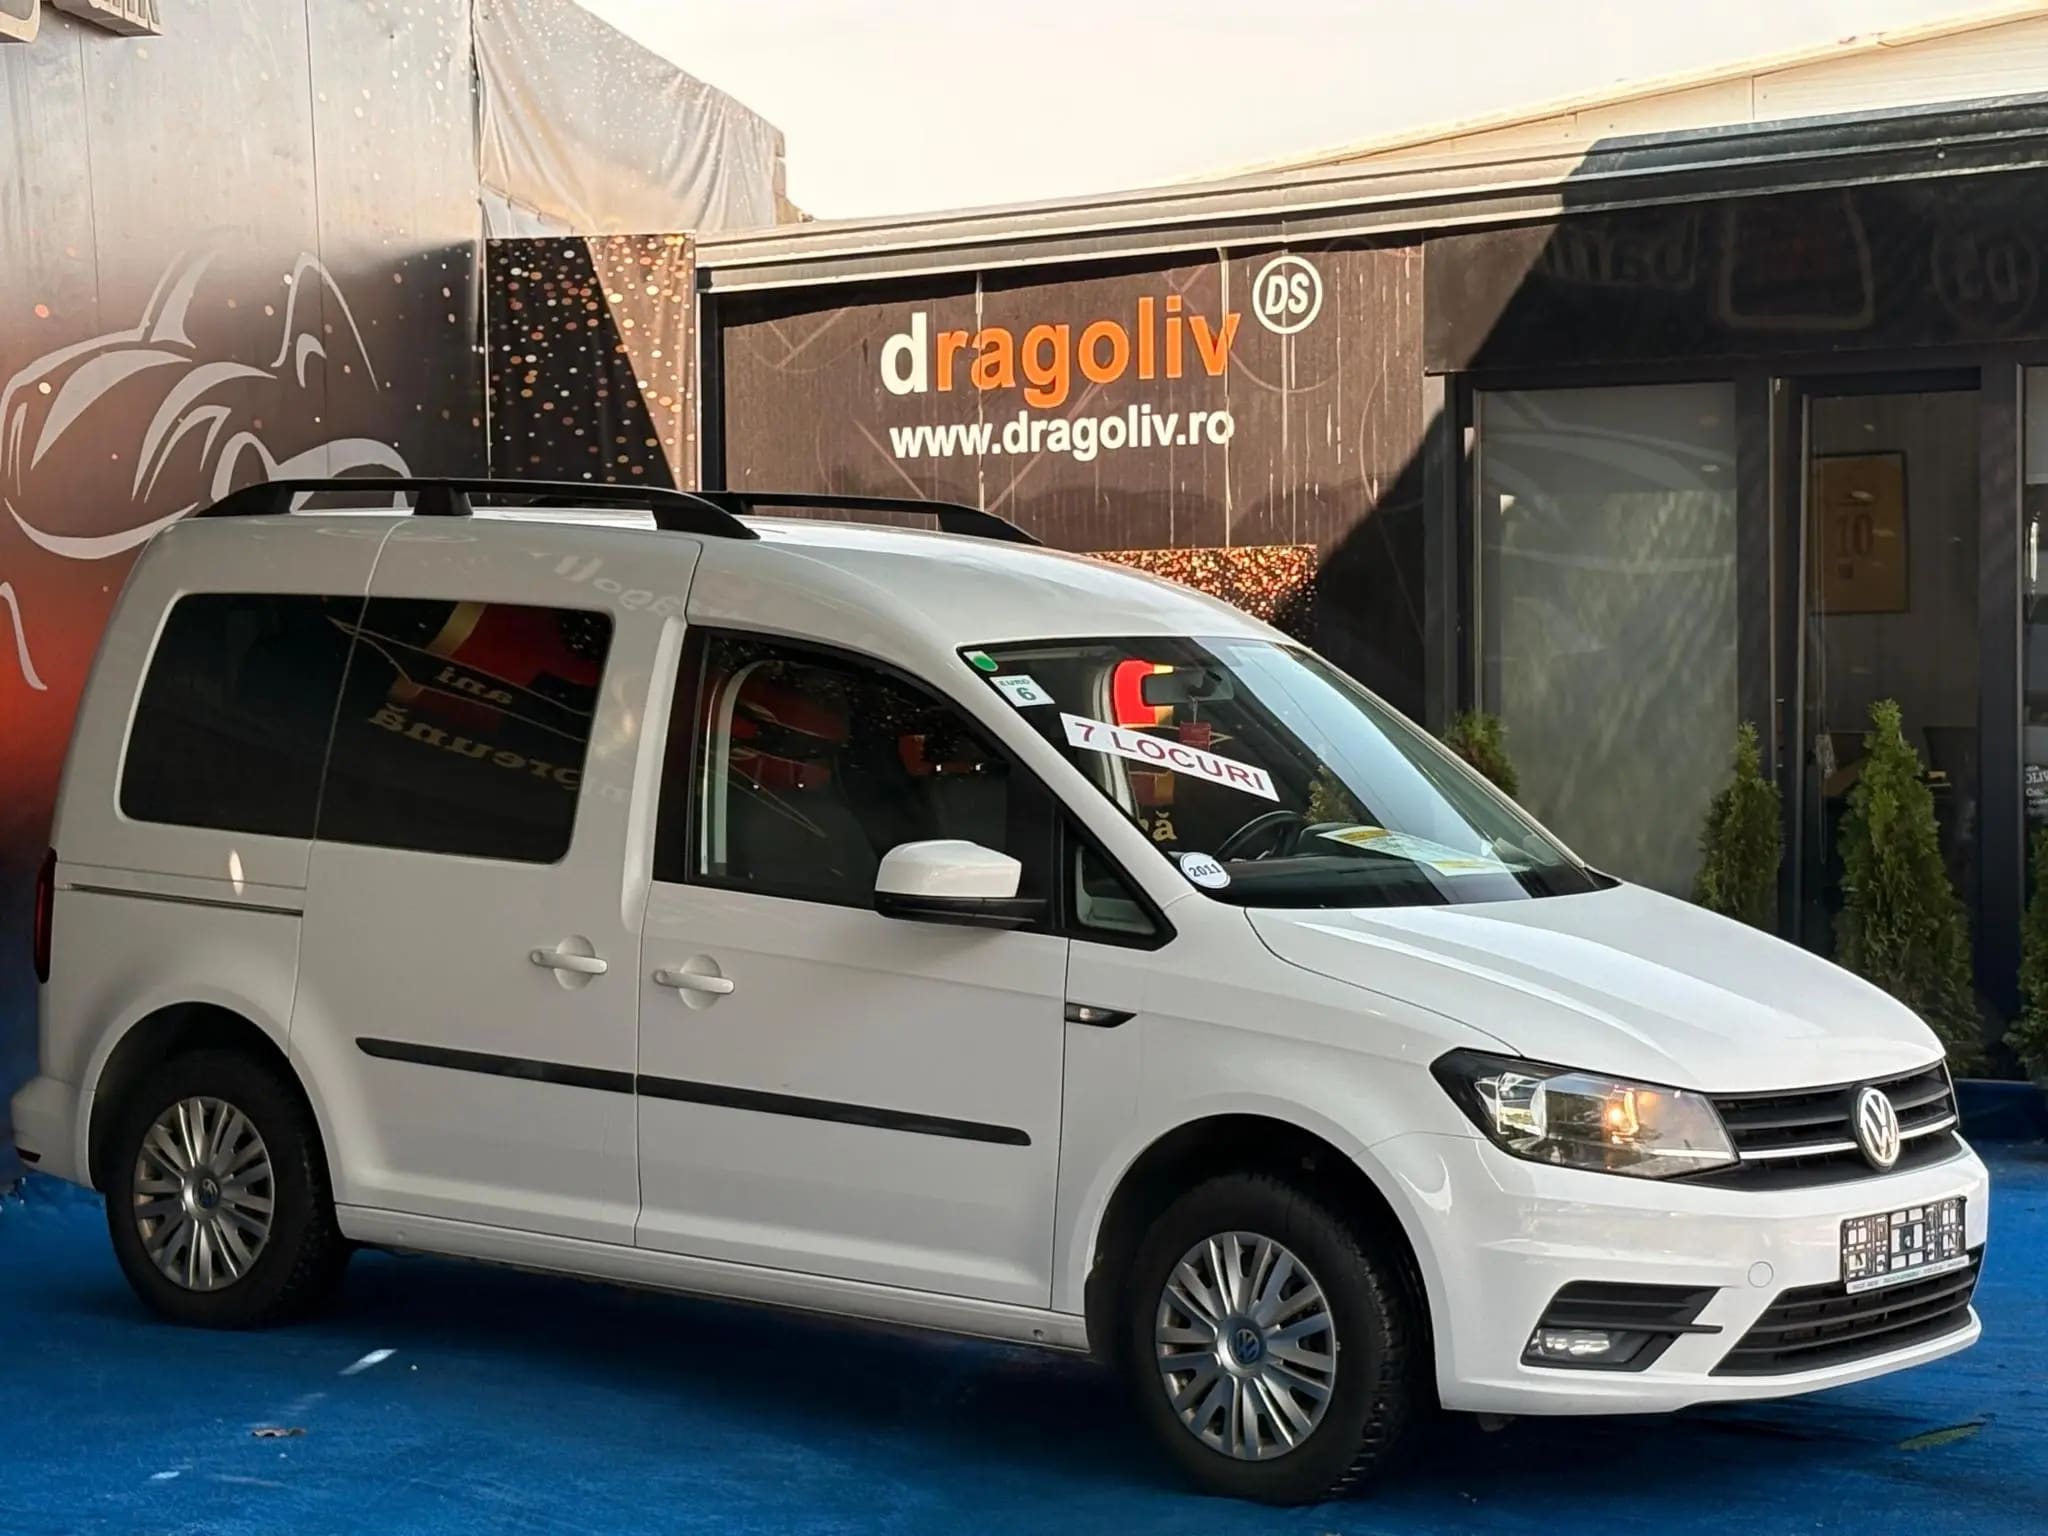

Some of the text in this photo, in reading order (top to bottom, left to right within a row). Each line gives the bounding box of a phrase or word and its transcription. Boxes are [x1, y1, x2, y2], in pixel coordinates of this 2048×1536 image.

[1265, 272, 1310, 315] DS
[880, 295, 1241, 409] dragoliv
[889, 403, 1236, 462] www.dragoliv.ro
[1016, 687, 1037, 701] 6
[1074, 722, 1265, 791] 7 LOCURI
[1188, 863, 1222, 877] 2011
